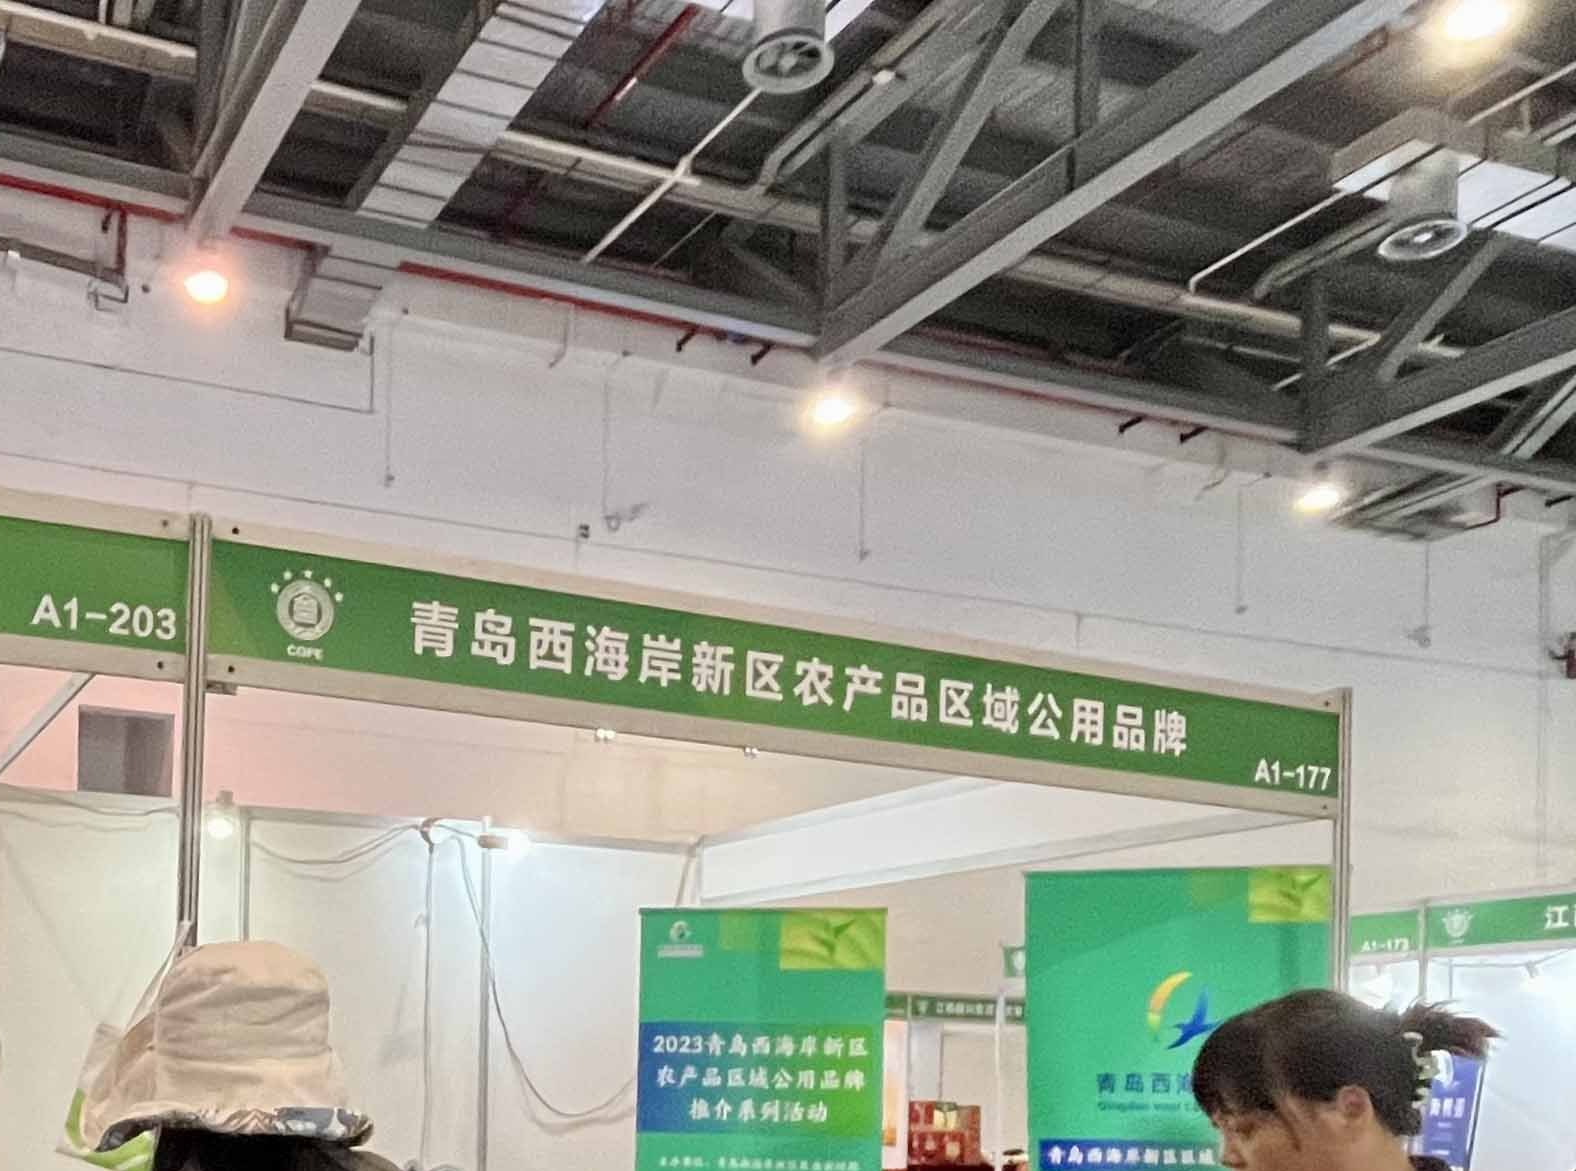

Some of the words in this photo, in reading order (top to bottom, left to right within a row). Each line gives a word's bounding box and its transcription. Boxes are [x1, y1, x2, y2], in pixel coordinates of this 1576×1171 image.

[31, 594, 178, 641] A1-203
[410, 601, 1189, 756] 青岛西海岸新区农产品区域公用品牌
[1254, 758, 1331, 791] A1-177
[1544, 905, 1576, 930] 江
[656, 1065, 866, 1091] 农产品区域公用品牌
